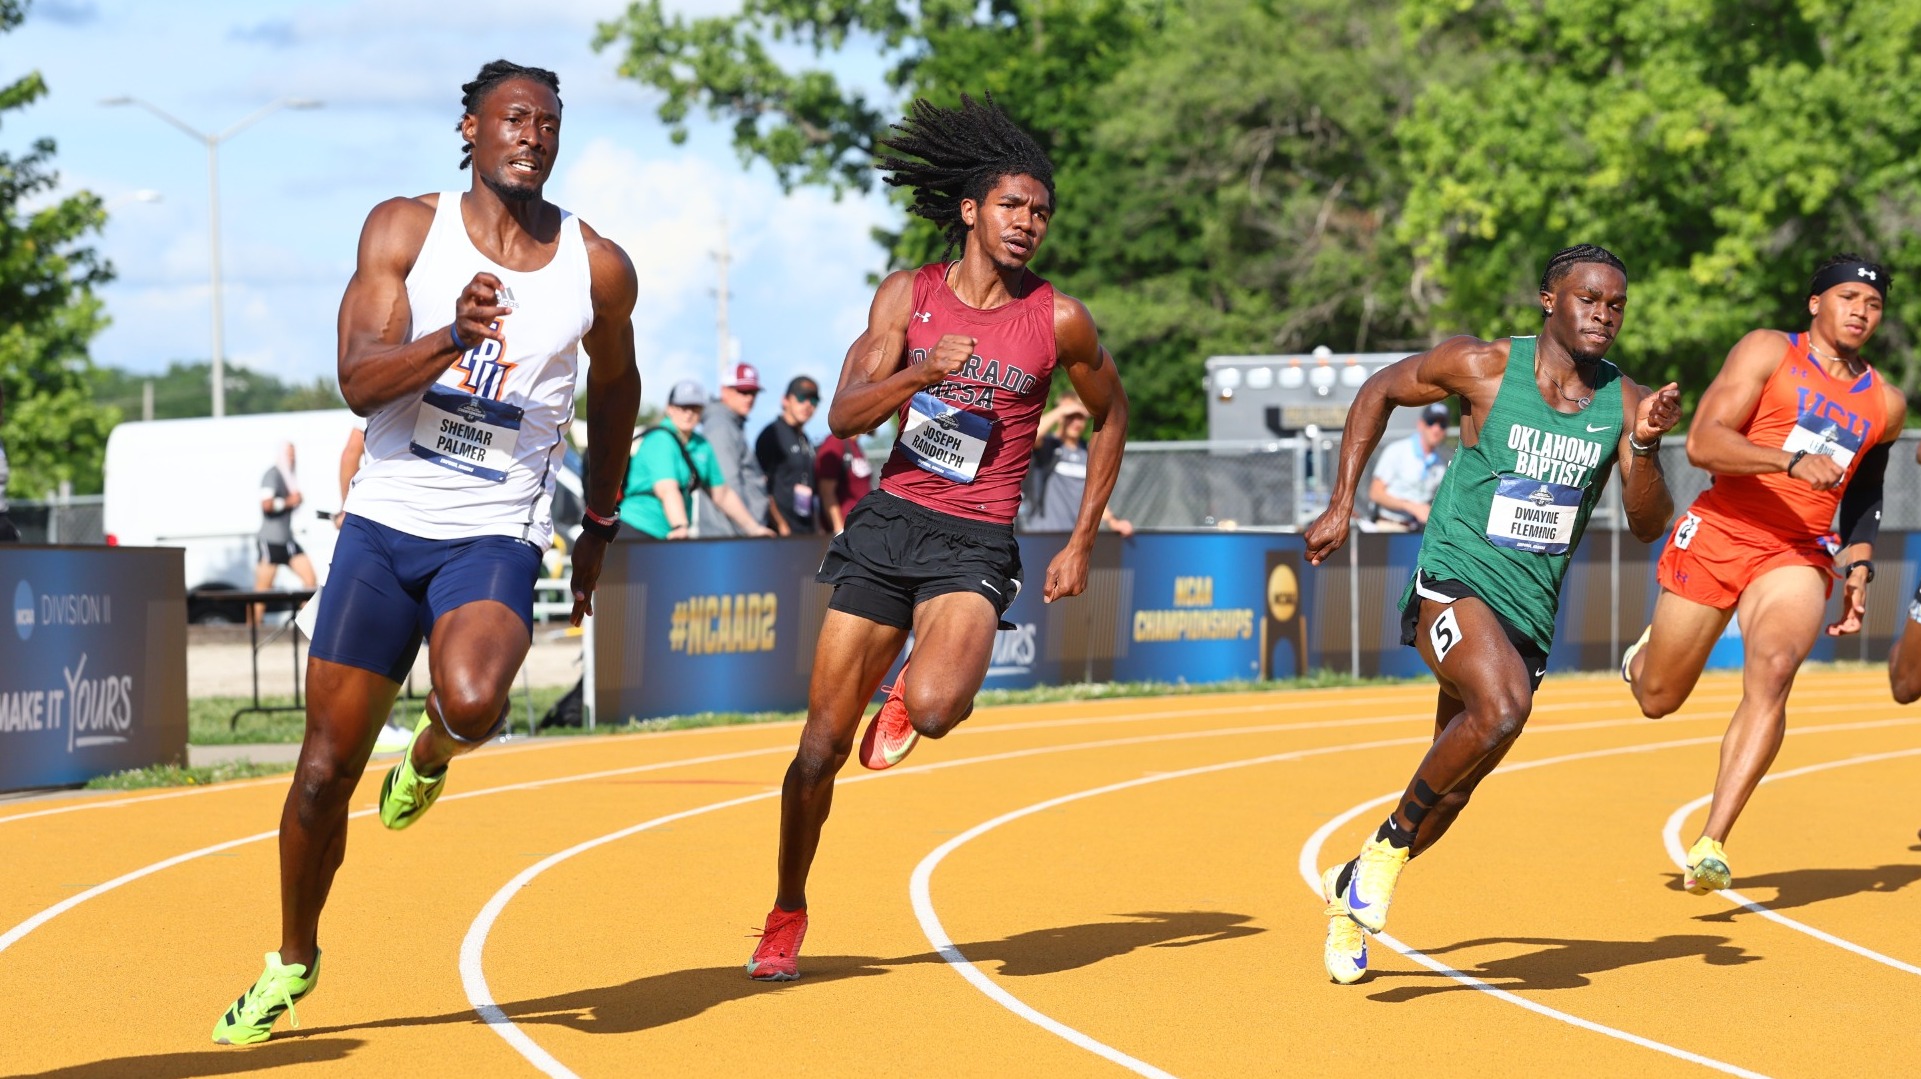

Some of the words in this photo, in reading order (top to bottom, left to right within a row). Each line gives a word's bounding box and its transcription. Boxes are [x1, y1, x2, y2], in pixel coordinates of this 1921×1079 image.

[436, 435, 487, 462] PALMER
[440, 418, 493, 446] SHEMAR
[923, 425, 962, 451] JOSEPH
[1507, 423, 1602, 469] OKLAHOMA
[911, 434, 965, 469] RANDOLPH
[1514, 451, 1588, 488] BAPTIST
[1510, 521, 1557, 540] FLEMING
[1514, 506, 1560, 525] DWAYNE
[41, 594, 100, 626] DIVISION
[669, 592, 777, 656] #NCAAD2
[1134, 608, 1254, 642] CHAMPIONSHIPS
[1435, 614, 1453, 654] 5
[0, 690, 45, 733] MAKE
[46, 689, 65, 729] IT
[63, 651, 133, 753] YOURS
